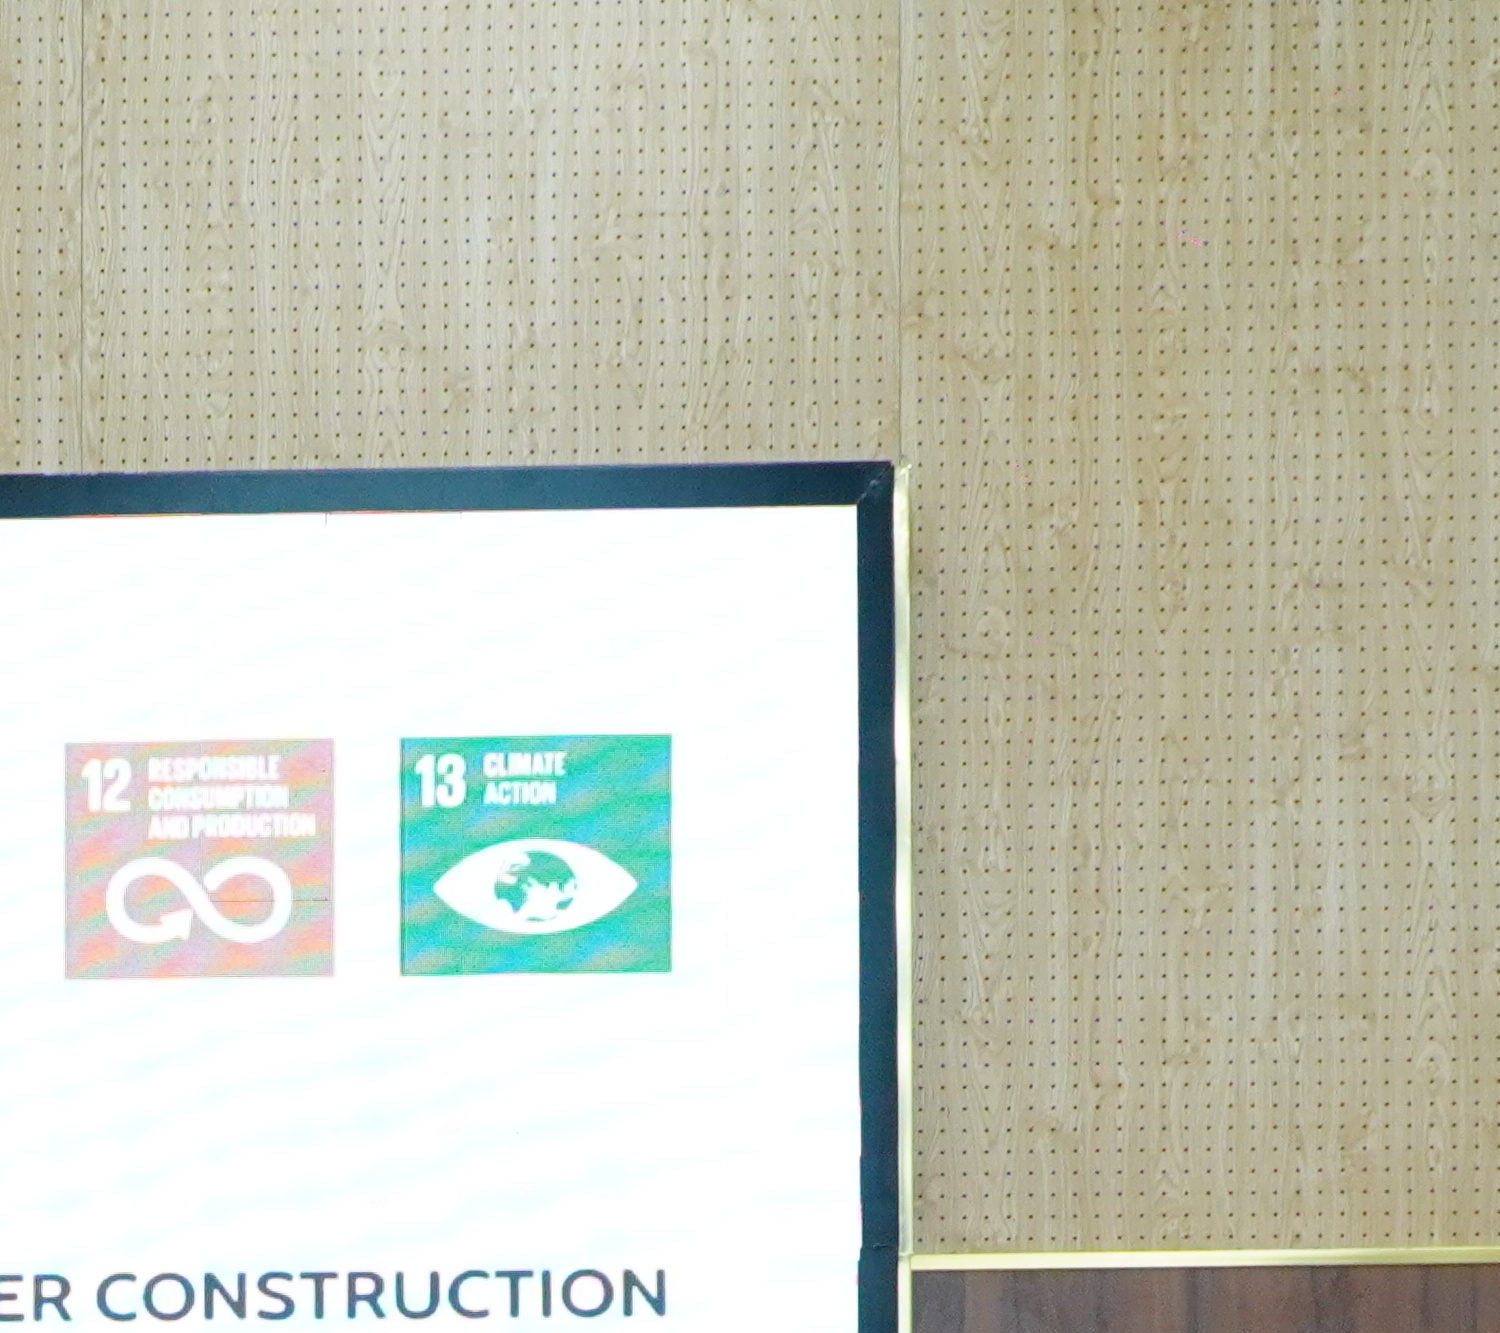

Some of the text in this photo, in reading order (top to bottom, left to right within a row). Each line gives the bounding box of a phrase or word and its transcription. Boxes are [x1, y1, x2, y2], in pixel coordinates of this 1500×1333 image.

[82, 758, 132, 812] 12
[415, 754, 467, 808] 13
[483, 751, 566, 778] CLIMATE
[483, 781, 556, 806] ACTION
[97, 1269, 665, 1321] CONSTRUCTION
